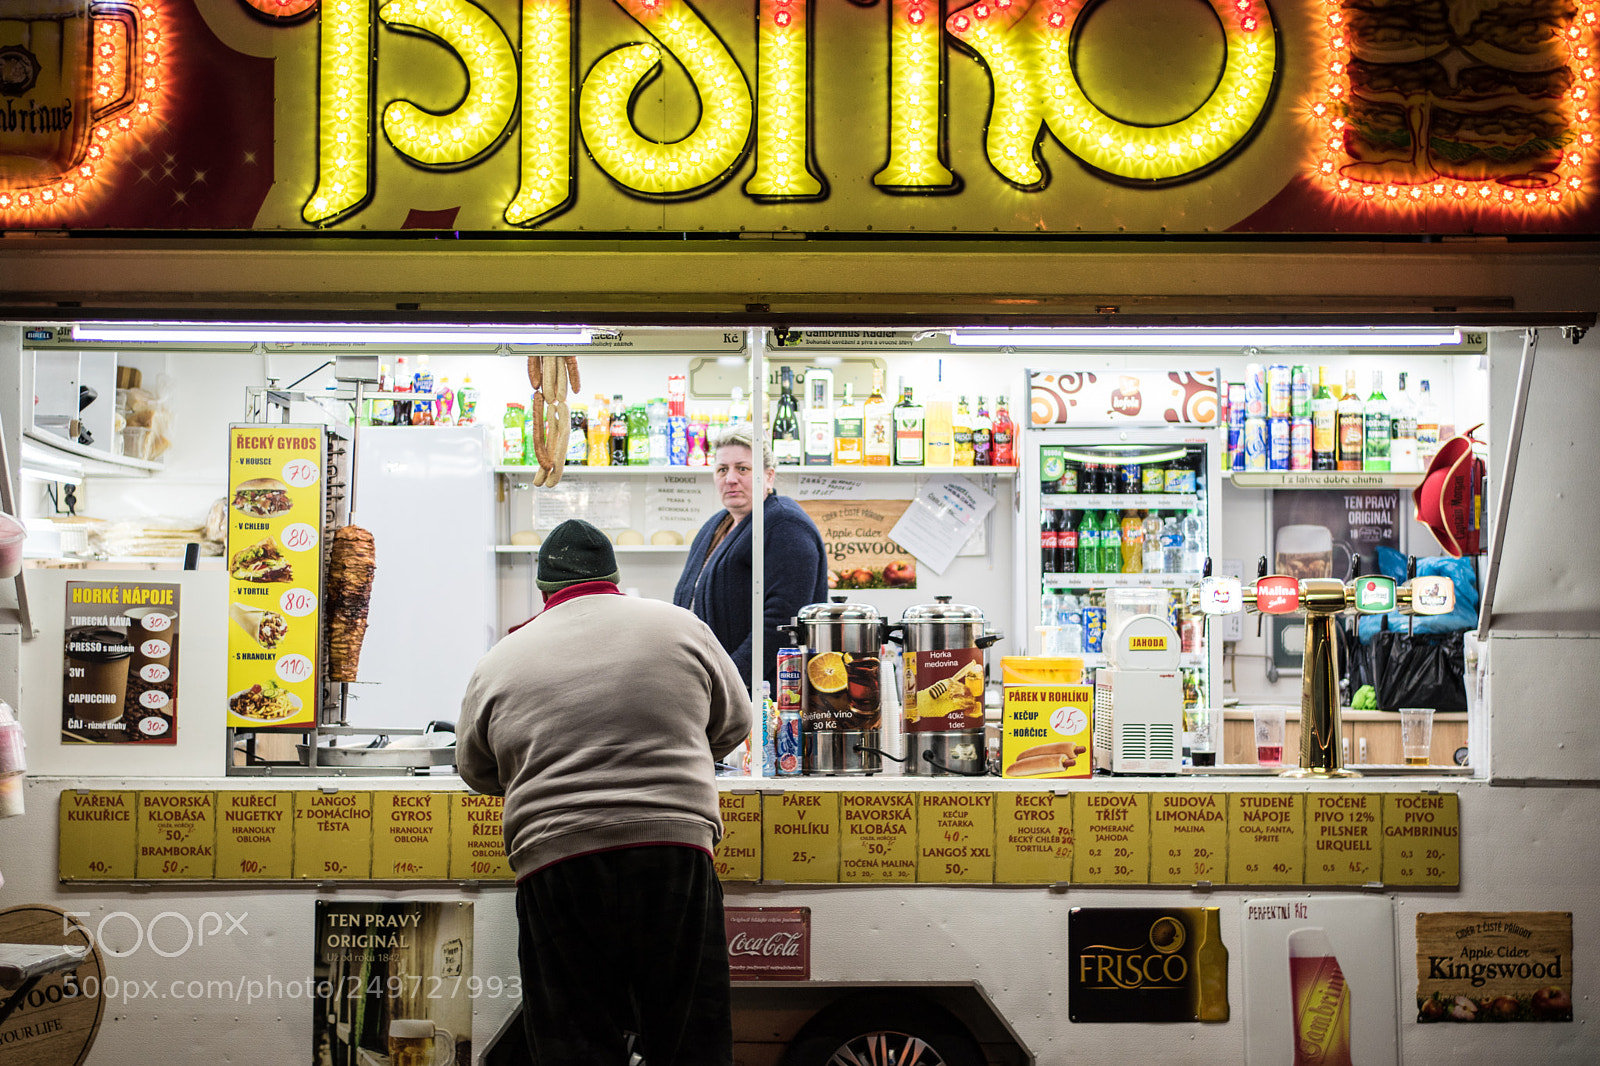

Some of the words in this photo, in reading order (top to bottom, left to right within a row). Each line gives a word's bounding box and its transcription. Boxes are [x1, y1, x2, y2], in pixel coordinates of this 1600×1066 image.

[723, 333, 739, 344] Kč
[1467, 334, 1482, 344] Kč
[236, 434, 275, 450] ŘECKÝ
[277, 436, 317, 451] GYROS
[245, 457, 272, 466] HOUSCE
[1323, 475, 1350, 484] dobře
[1352, 475, 1383, 484] chutná
[1450, 475, 1465, 508] Morgan
[1344, 496, 1364, 509] TEN
[1365, 493, 1397, 509] PRAVÝ
[1348, 509, 1393, 525] ORIGINÁL
[244, 522, 270, 531] CHLEBU
[1453, 507, 1466, 540] Captain
[825, 527, 852, 540] Apple
[855, 527, 882, 538] Cider
[1350, 529, 1358, 539] 18
[1383, 529, 1392, 539] 42
[72, 585, 119, 604] HORKÉ
[122, 586, 173, 605] NÁPOJE
[243, 588, 269, 596] TORTILE
[1259, 585, 1296, 596] Malina
[70, 615, 108, 627] TURECKÁ
[109, 615, 132, 627] KÁVA
[69, 642, 102, 652] PRESSO
[1132, 638, 1164, 647] JAHODA
[241, 652, 277, 662] HRANOLKY
[924, 660, 959, 669] medovina
[69, 667, 85, 678] 3V1
[780, 672, 800, 680] BIRELL
[68, 694, 117, 704] CAPUCCINO
[1009, 690, 1039, 703] PÁREK
[1040, 692, 1047, 702] V
[1048, 690, 1089, 703] ROHLÍKU
[833, 711, 853, 721] víno
[1013, 710, 1039, 721] KEČUP
[67, 717, 84, 730] ČAJ
[813, 721, 825, 730] 30
[825, 720, 838, 730] Kč
[948, 721, 965, 730] 1dec
[1013, 727, 1048, 738] HOŘČICE
[73, 794, 125, 808] VAŘENÁ
[143, 794, 211, 808] BAVORSKÁ
[231, 794, 277, 808] KUŘECÍ
[311, 795, 357, 807] LANGOŠ
[392, 795, 432, 807] ŘECKÝ
[782, 794, 821, 807] PÁREK
[843, 794, 914, 807] MORAVSKÁ
[923, 795, 991, 807] HRANOLKY
[1015, 795, 1054, 807] ŘECKÝ
[1087, 795, 1138, 807] LEDOVÁ
[1163, 796, 1216, 808] SUDOVÁ
[1240, 796, 1294, 808] STUDENÉ
[1317, 796, 1367, 808] TOČENÉ
[1395, 796, 1444, 809] TOČENÉ
[68, 809, 130, 821] KUKUŘICE
[148, 809, 206, 821] KLOBÁSA
[225, 810, 283, 822] NUGETKY
[296, 810, 303, 819] Z
[307, 808, 371, 820] DOMÁCÍHO
[391, 811, 432, 821] GYROS
[797, 810, 806, 820] V
[845, 808, 912, 821] BAVORSKÁ
[942, 810, 969, 819] KEČUP
[1014, 810, 1055, 821] GYROS
[1095, 809, 1129, 821] TŘÍŠŤ
[1155, 810, 1224, 822] LIMONÁDA
[1243, 810, 1291, 823] NÁPOJE
[1314, 811, 1344, 822] PIVO
[1348, 811, 1375, 823] 12%
[1404, 812, 1435, 823] PIVO
[231, 826, 276, 834] HRANOLKY
[317, 822, 350, 832] TĚSTA
[390, 826, 433, 834] HRANOLKY
[774, 822, 830, 835] ROHLÍKU
[850, 822, 907, 835] KLOBÁSA
[938, 820, 974, 828] TATARKA
[1089, 824, 1135, 833] POMERANČ
[165, 830, 189, 842] 50,-
[1239, 826, 1263, 835] COLA,
[1320, 826, 1368, 837] PILSNER
[1385, 826, 1458, 837] GAMBRINUS
[1008, 834, 1034, 843] ŘECKÝ
[1035, 834, 1061, 843] CHLÉB
[1095, 834, 1129, 842] JAHODA
[1254, 835, 1280, 843] SPRITE
[141, 845, 212, 857] BRAMBORÁK
[723, 845, 756, 857] ŽEMLI
[868, 843, 892, 856] 50,-
[922, 845, 967, 858] LANGOŠ
[969, 848, 991, 858] XXL
[1316, 840, 1372, 852] URQUELL
[792, 852, 816, 864] 25,-
[1114, 848, 1134, 859] 20,-
[1193, 848, 1214, 859] 20,-
[1425, 849, 1446, 861] 20,-
[88, 861, 113, 873] 40,-
[324, 861, 348, 873] 50,-
[844, 858, 879, 868] TOČENÁ
[881, 860, 915, 868] MALINA
[1272, 863, 1293, 874] 40,-
[945, 864, 969, 877] 50,-
[1114, 866, 1134, 877] 30,-
[1248, 903, 1291, 920] PERFEKTNÍ
[1294, 902, 1308, 919] ŘÍZ
[327, 913, 361, 928] TEN
[365, 911, 422, 928] PRAVÝ
[1455, 925, 1474, 940] CIDER
[1483, 920, 1502, 932] ČISTÉ
[1503, 922, 1533, 940] PŘÍRODY
[327, 931, 410, 949] ORIGINÁL
[728, 931, 803, 957] Coca-Cola
[1460, 946, 1494, 961] Apple
[1497, 945, 1530, 958] Cider
[1080, 954, 1188, 989] FRISCO
[1427, 954, 1563, 988] Kingswood
[34, 1019, 63, 1036] LIFE
